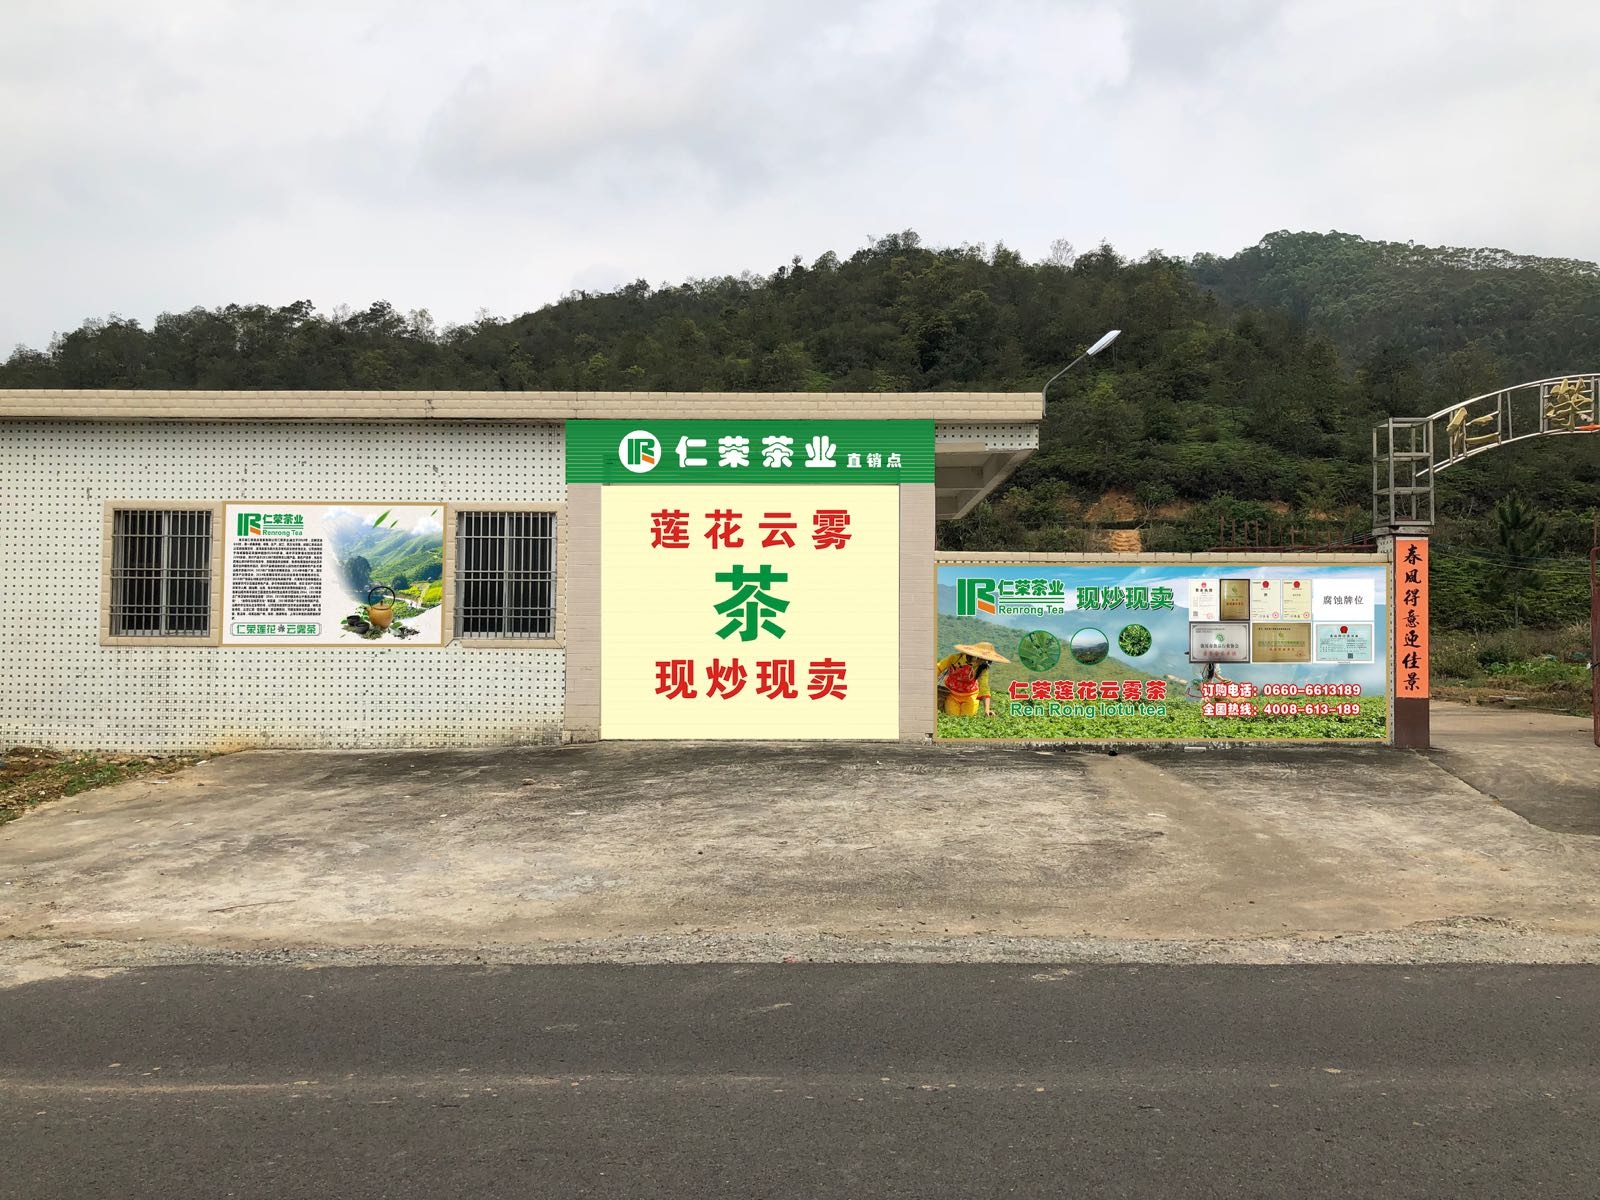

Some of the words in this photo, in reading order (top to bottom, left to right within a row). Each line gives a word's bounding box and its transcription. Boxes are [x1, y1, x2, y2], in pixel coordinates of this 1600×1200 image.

[675, 435, 837, 468] 仁荣茶业
[846, 452, 902, 468] 直销点
[262, 514, 304, 525] 仁荣茶业
[262, 529, 290, 537] Renrong
[650, 509, 852, 550] 莲花云雾
[998, 579, 1065, 596] 仁荣茶业
[713, 564, 790, 642] 茶
[1076, 586, 1174, 611] 现炒现卖
[1322, 595, 1364, 606] 腐蚀牌位
[999, 604, 1044, 616] Renrong
[1045, 604, 1064, 614] Tea
[655, 658, 849, 701] 现炒现卖
[1008, 680, 1167, 700] 仁荣莲花云雾茶
[1263, 684, 1361, 696] 0660-6613189
[1011, 703, 1044, 716] Ren
[1049, 703, 1095, 718] Rong
[1100, 703, 1135, 716] lotu
[1140, 704, 1166, 716] tea
[1263, 704, 1360, 715] 4008-613-189
